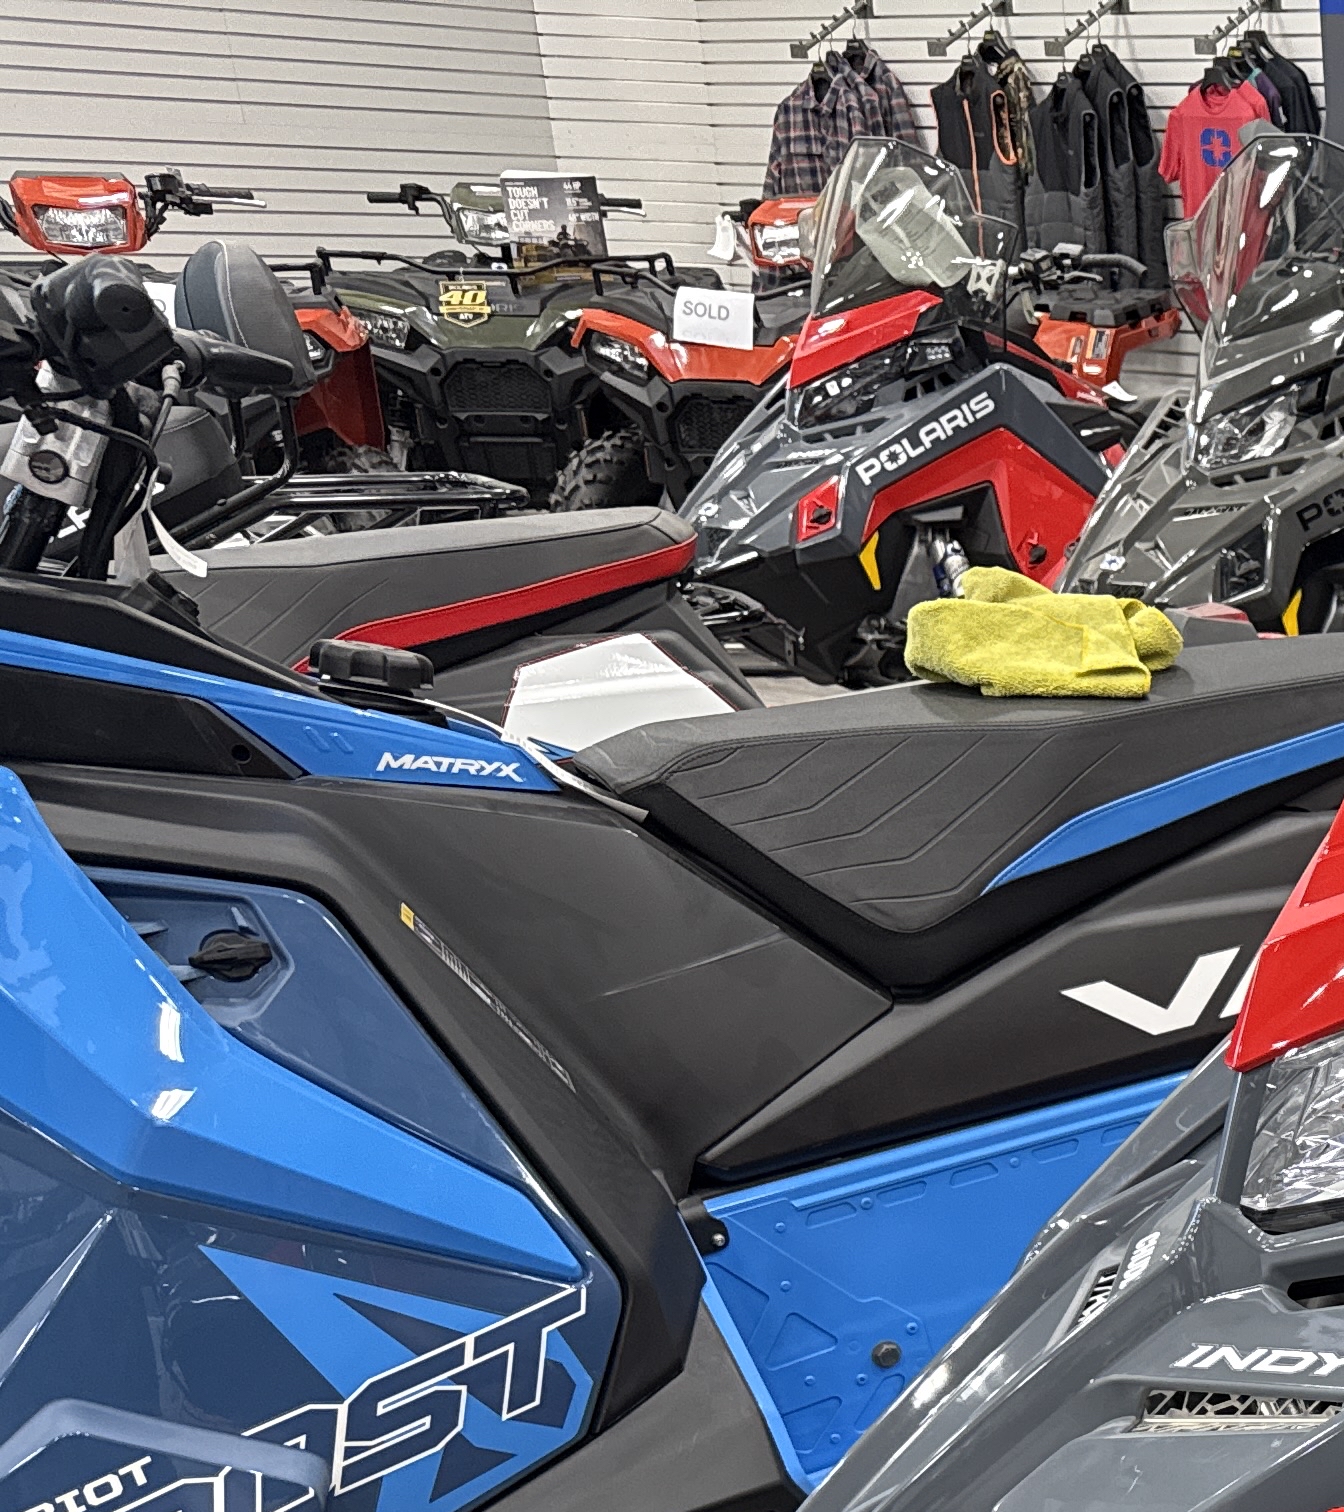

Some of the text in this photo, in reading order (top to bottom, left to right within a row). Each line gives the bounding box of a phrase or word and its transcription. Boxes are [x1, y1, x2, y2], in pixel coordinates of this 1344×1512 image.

[506, 186, 538, 198] TOUGH
[508, 197, 549, 209] DOESN'T
[510, 209, 529, 220] CUT
[512, 220, 555, 231] CORNERS
[439, 290, 486, 304] 40
[682, 300, 730, 321] SOLD
[854, 391, 995, 486] POLARIS
[376, 751, 525, 783] MATRYX
[1060, 946, 1265, 1035] V
